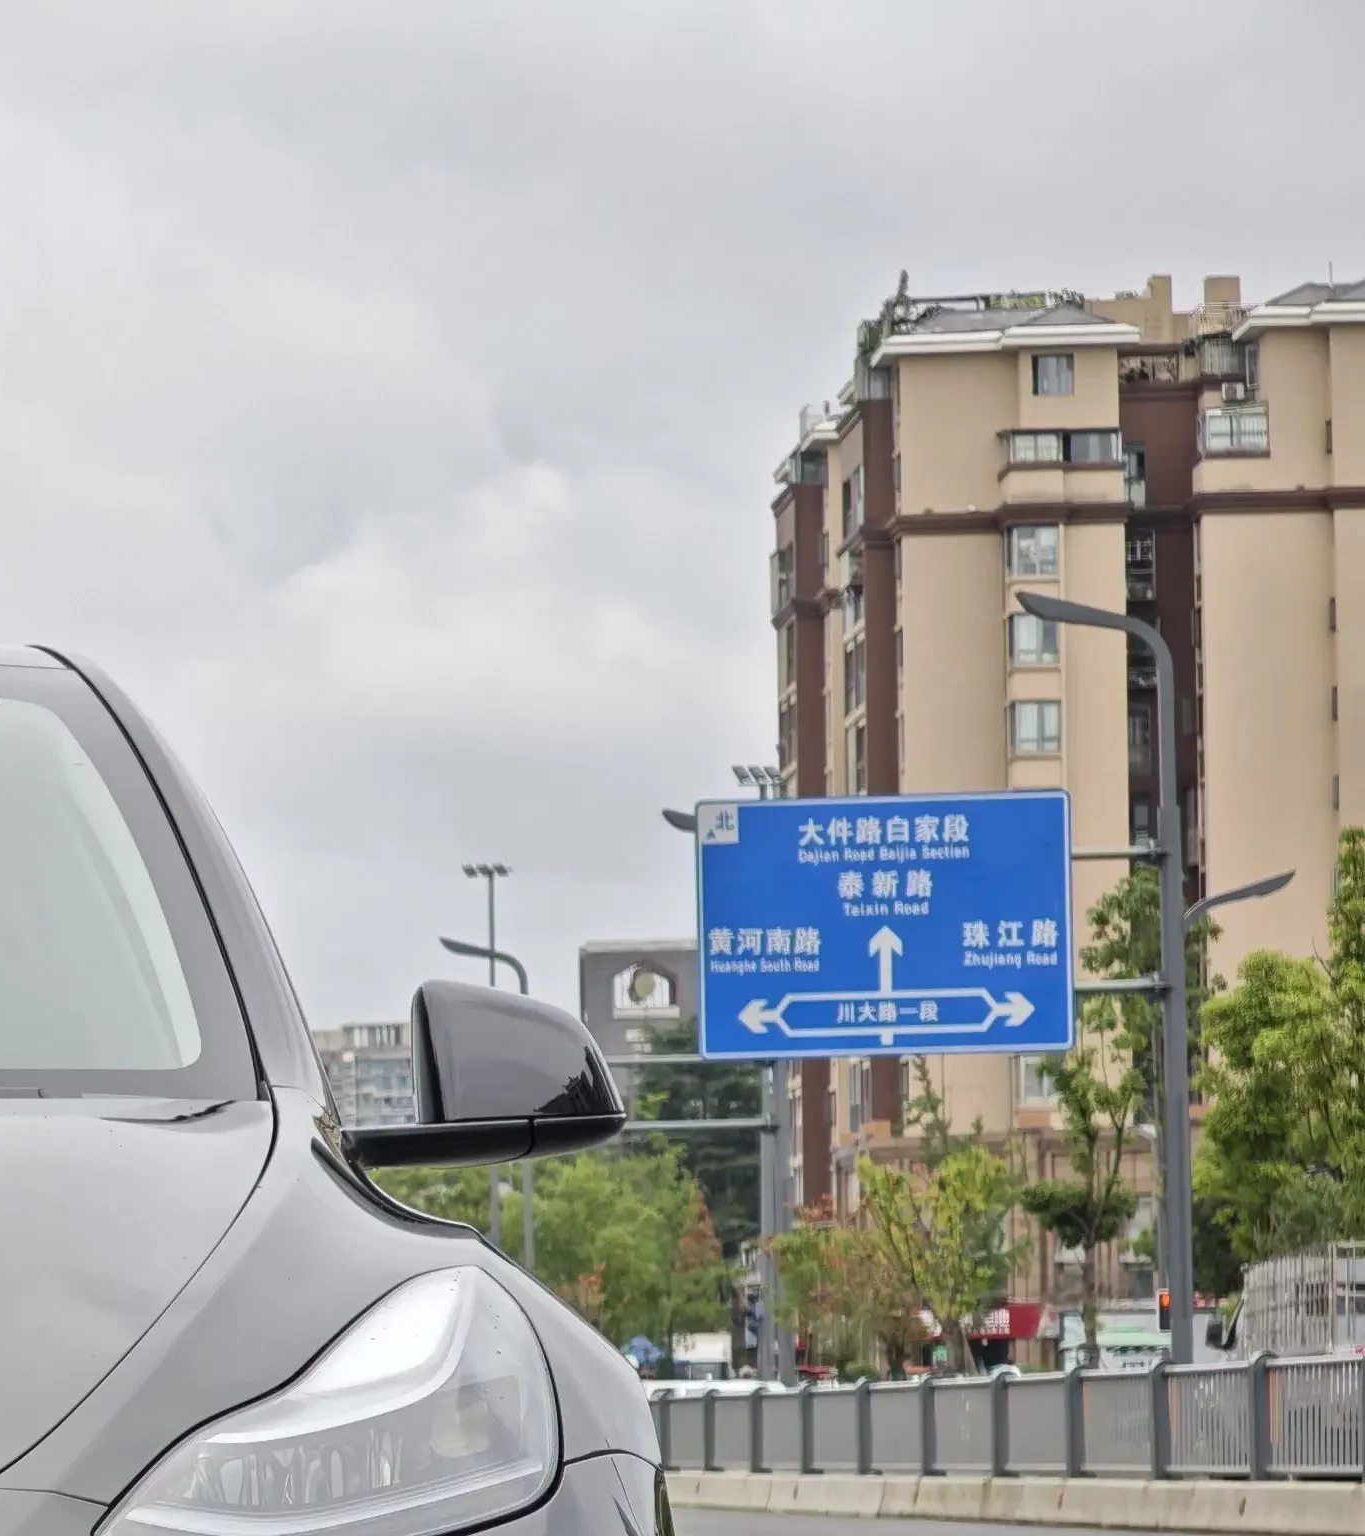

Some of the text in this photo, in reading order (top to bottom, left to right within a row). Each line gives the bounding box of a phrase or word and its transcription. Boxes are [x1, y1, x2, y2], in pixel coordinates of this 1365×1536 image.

[714, 810, 735, 831] 北
[798, 814, 969, 846] 大件路白家段
[798, 847, 840, 865] Dajian
[844, 847, 875, 862] Road
[922, 844, 970, 860] Section
[837, 869, 933, 899] 泰新路
[843, 900, 930, 917] Taixin Road
[708, 926, 821, 956] 黄河南路
[962, 918, 1058, 949] 珠江路
[710, 957, 820, 976] Huanghe South Road
[964, 950, 1058, 971] Zhujiang Road
[837, 1000, 938, 1024] 川大路一段
